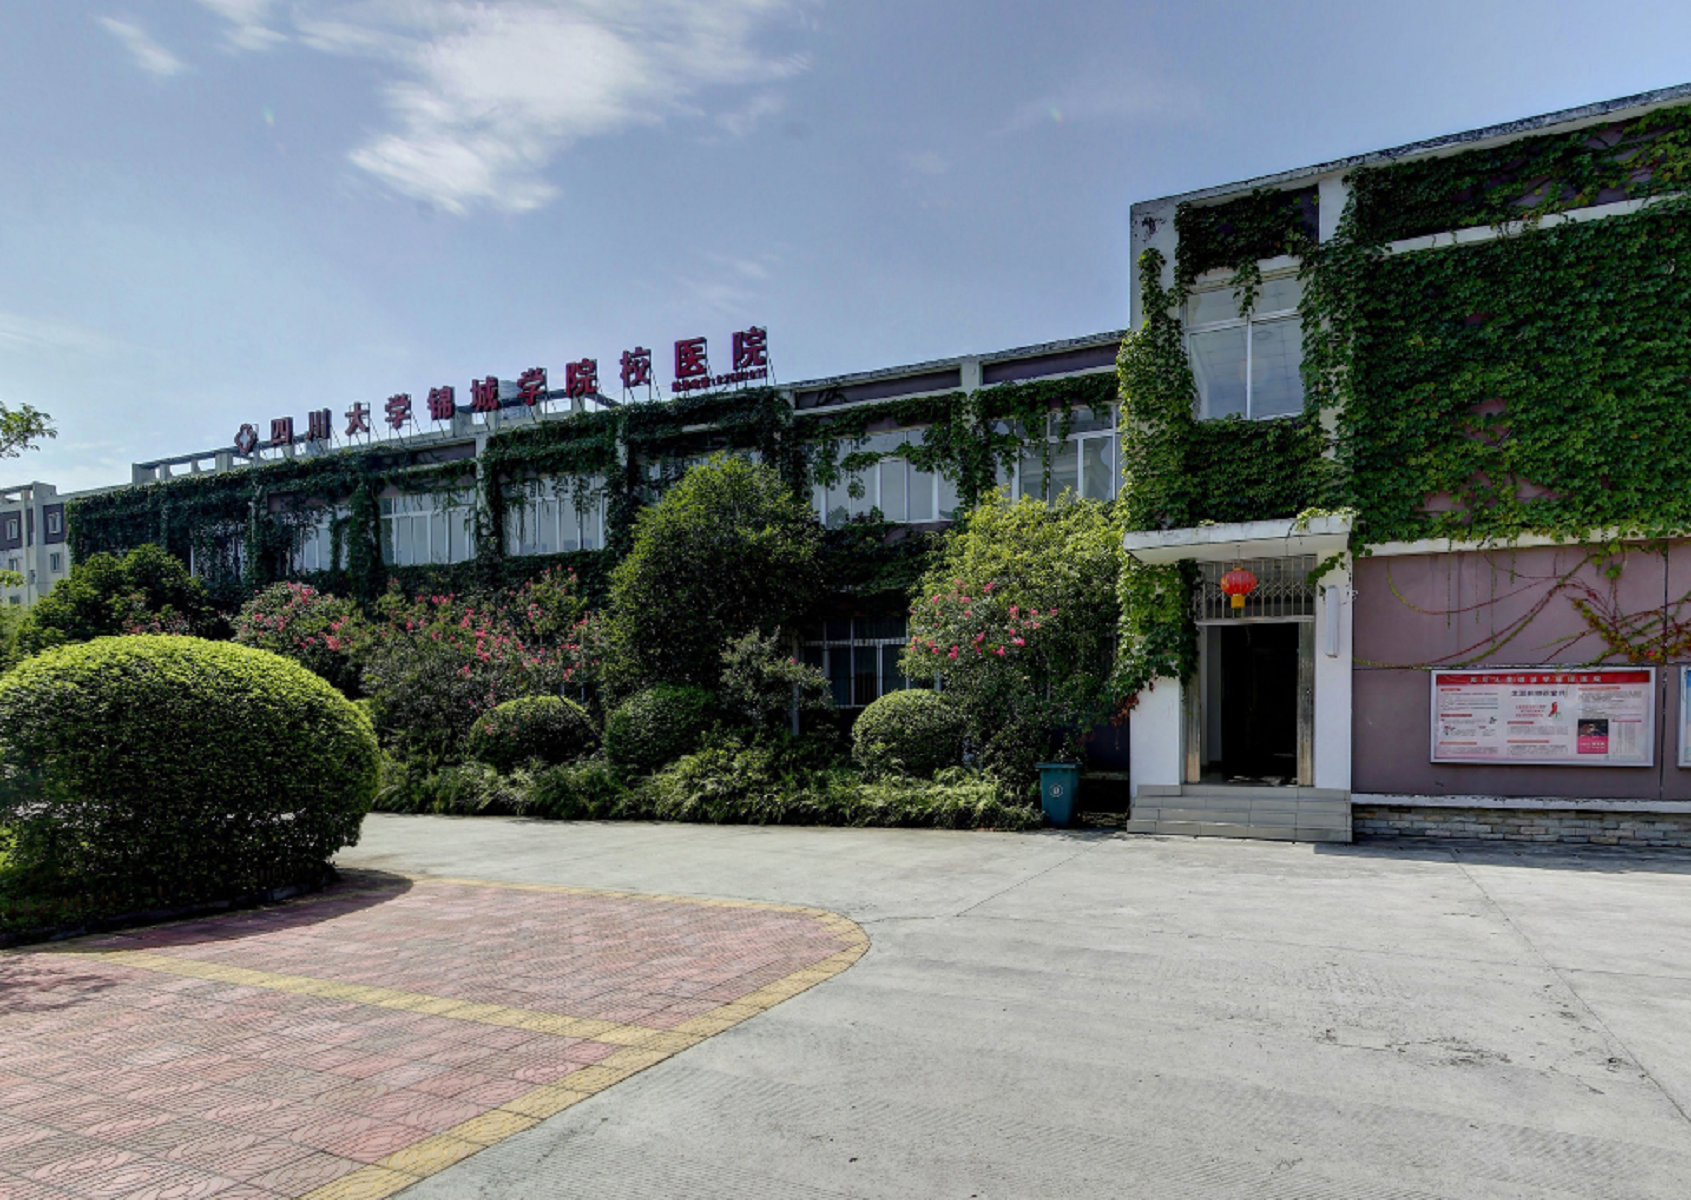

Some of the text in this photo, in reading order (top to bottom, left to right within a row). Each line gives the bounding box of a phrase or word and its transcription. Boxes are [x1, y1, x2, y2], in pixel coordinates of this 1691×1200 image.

[270, 326, 767, 444] 四川大学锦城学院校医院
